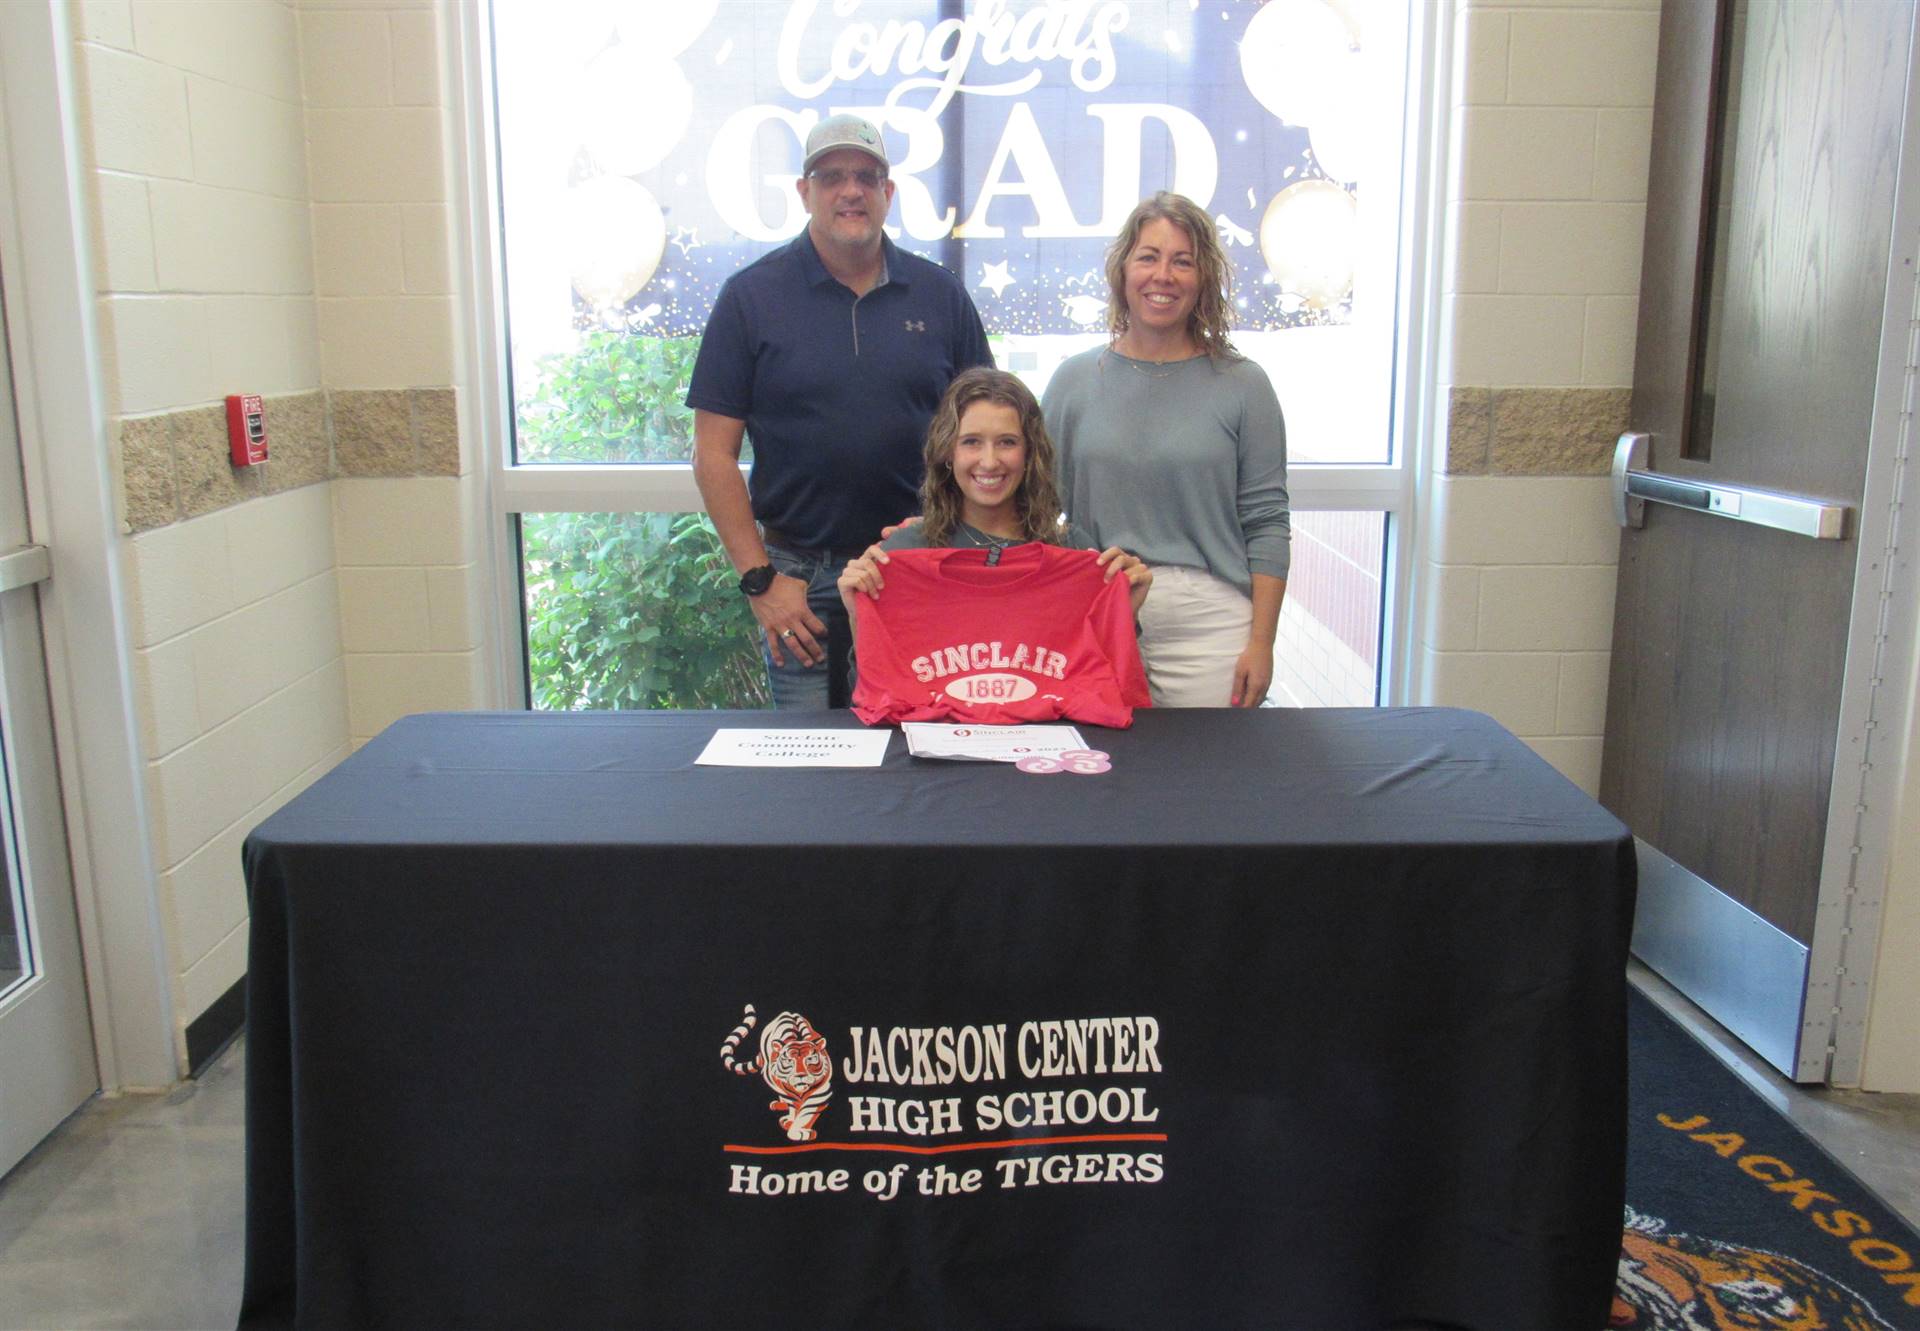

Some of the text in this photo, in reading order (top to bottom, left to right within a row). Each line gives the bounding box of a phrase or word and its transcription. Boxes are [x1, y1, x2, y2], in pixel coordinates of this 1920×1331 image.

[777, 0, 1131, 119] Congrats
[705, 101, 1219, 242] GRAD
[244, 397, 262, 413] FIRE
[911, 641, 1068, 682] SINCLAIR
[966, 678, 1018, 699] 1887
[738, 742, 858, 750] Community
[755, 750, 832, 759] College
[843, 1016, 1162, 1085] JACKSON CENTER
[848, 1087, 1160, 1136] HIGH SCHOOL
[729, 1153, 1165, 1201] Home of the TIGERS
